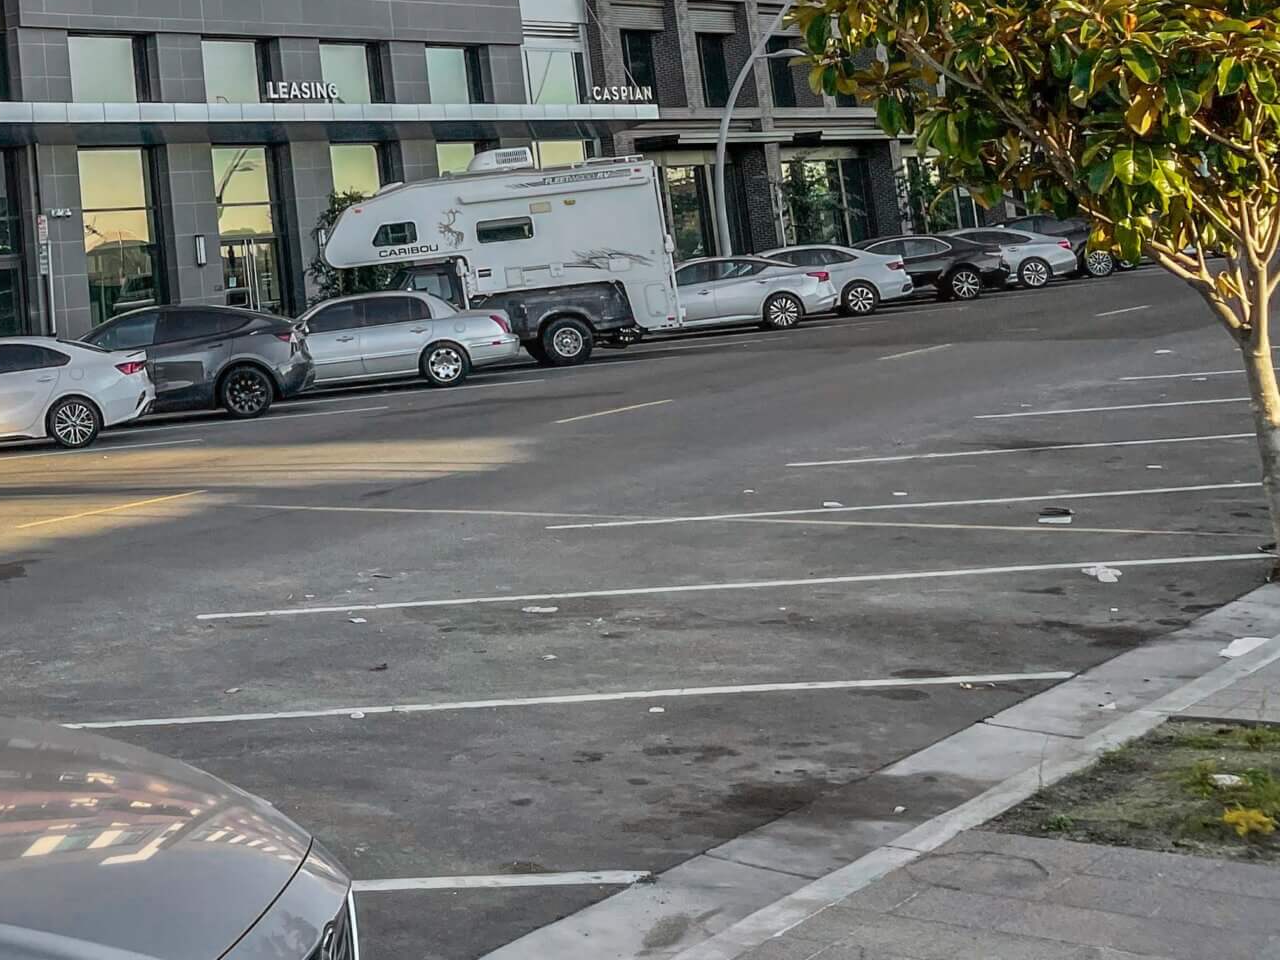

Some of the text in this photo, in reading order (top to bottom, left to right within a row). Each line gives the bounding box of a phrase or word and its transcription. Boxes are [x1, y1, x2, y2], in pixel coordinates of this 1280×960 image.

[266, 81, 338, 99] LEASING
[593, 86, 653, 101] CASPIAN
[545, 173, 596, 185] FLEETW
[379, 243, 439, 258] CARIBOU
